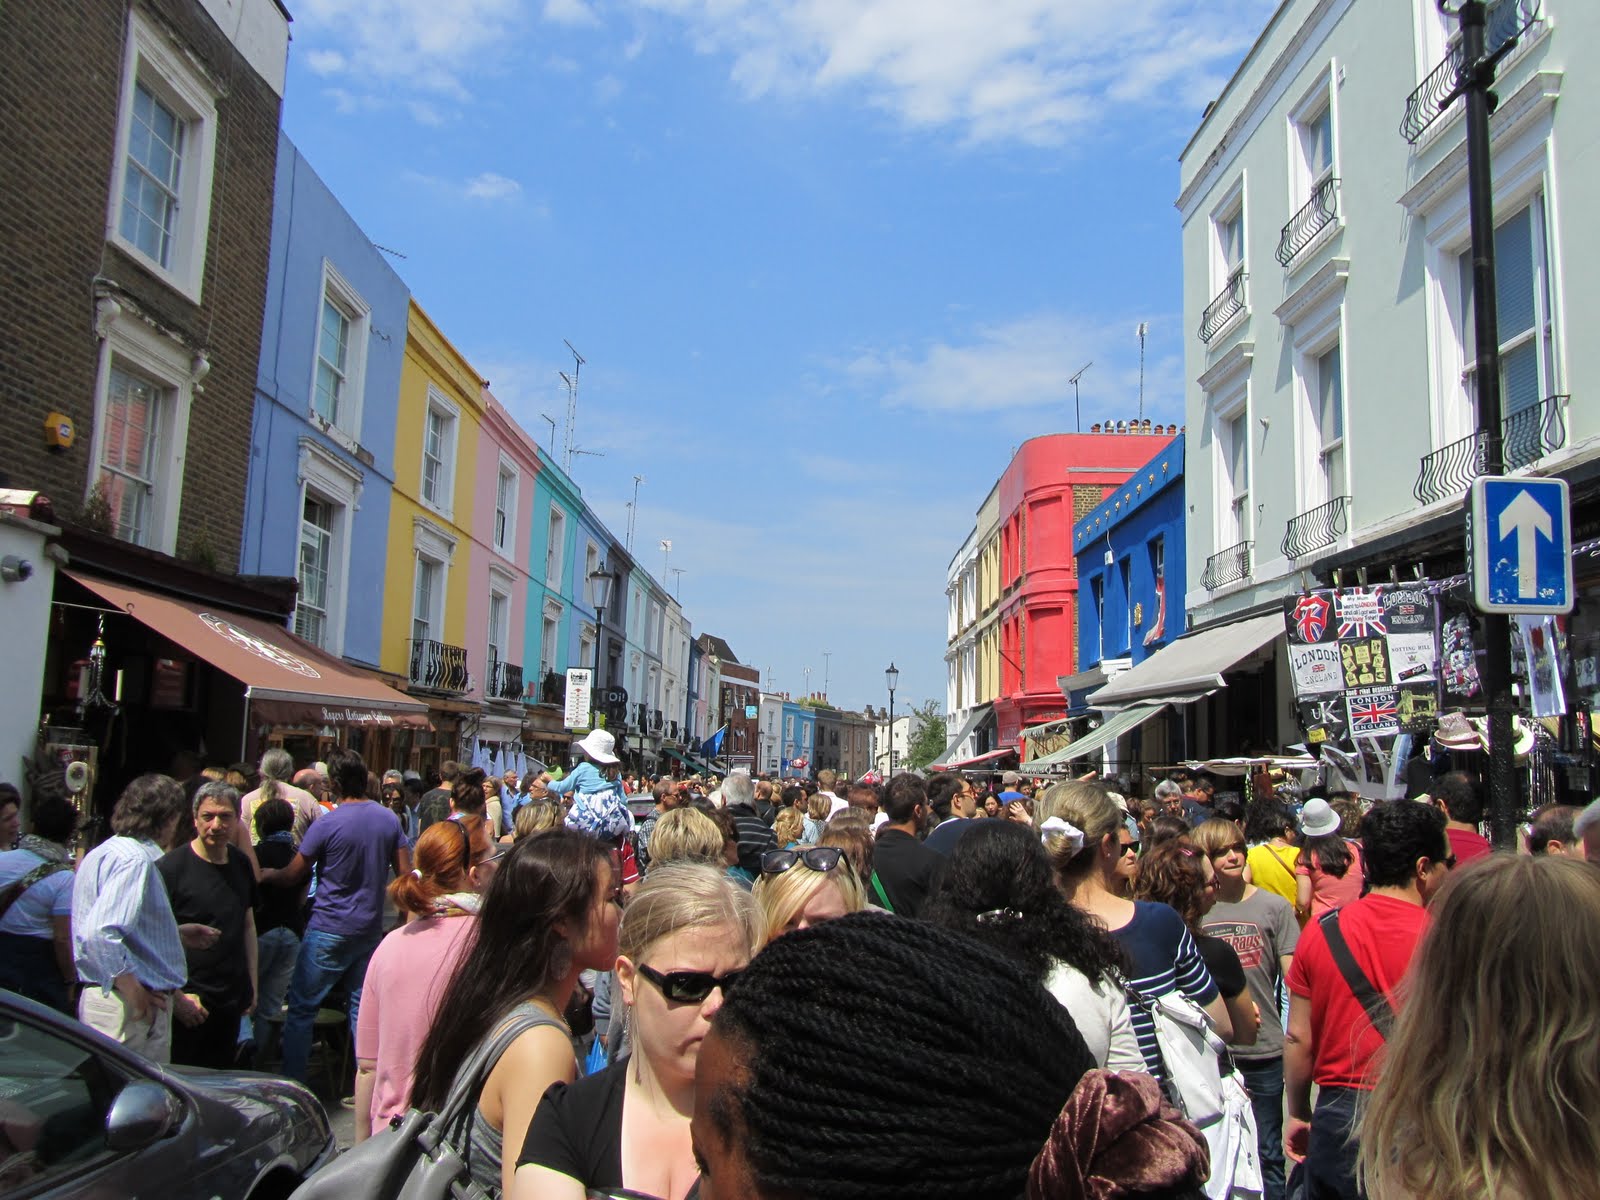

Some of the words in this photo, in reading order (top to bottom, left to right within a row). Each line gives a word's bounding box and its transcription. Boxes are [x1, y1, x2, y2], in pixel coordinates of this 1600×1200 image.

[1383, 590, 1428, 610] LONDON
[1295, 648, 1339, 670] LONDON
[1304, 671, 1338, 685] ENGLAND
[609, 692, 625, 702] Oi!
[1350, 694, 1394, 705] LONDON
[1354, 721, 1397, 731] ENGLAND
[1235, 925, 1248, 935] 98
